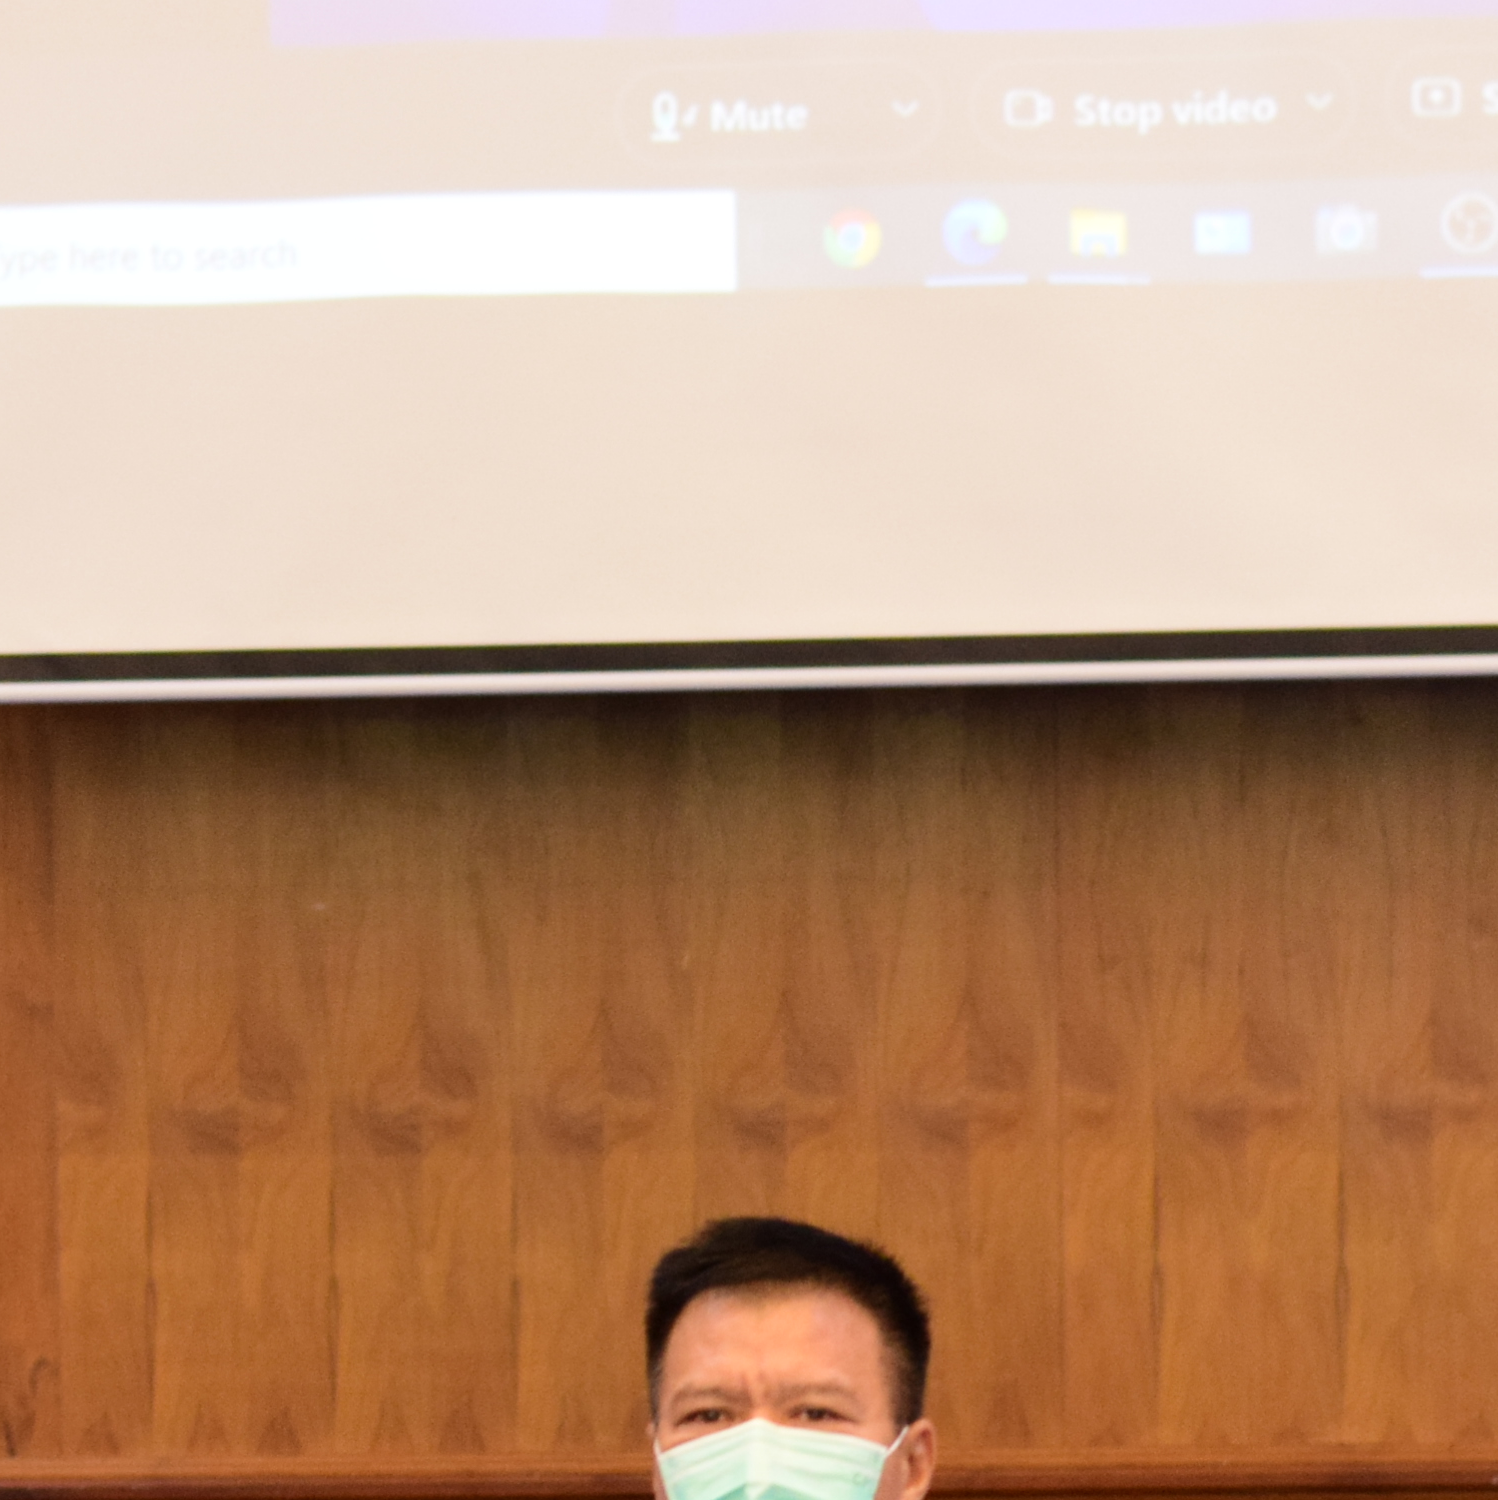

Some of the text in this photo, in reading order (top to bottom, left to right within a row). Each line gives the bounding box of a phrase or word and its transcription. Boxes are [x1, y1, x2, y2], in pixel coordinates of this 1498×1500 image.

[708, 97, 810, 135] Mute
[1073, 88, 1279, 135] Stop video
[68, 241, 140, 272] here
[149, 243, 185, 272] to
[193, 238, 298, 272] search
